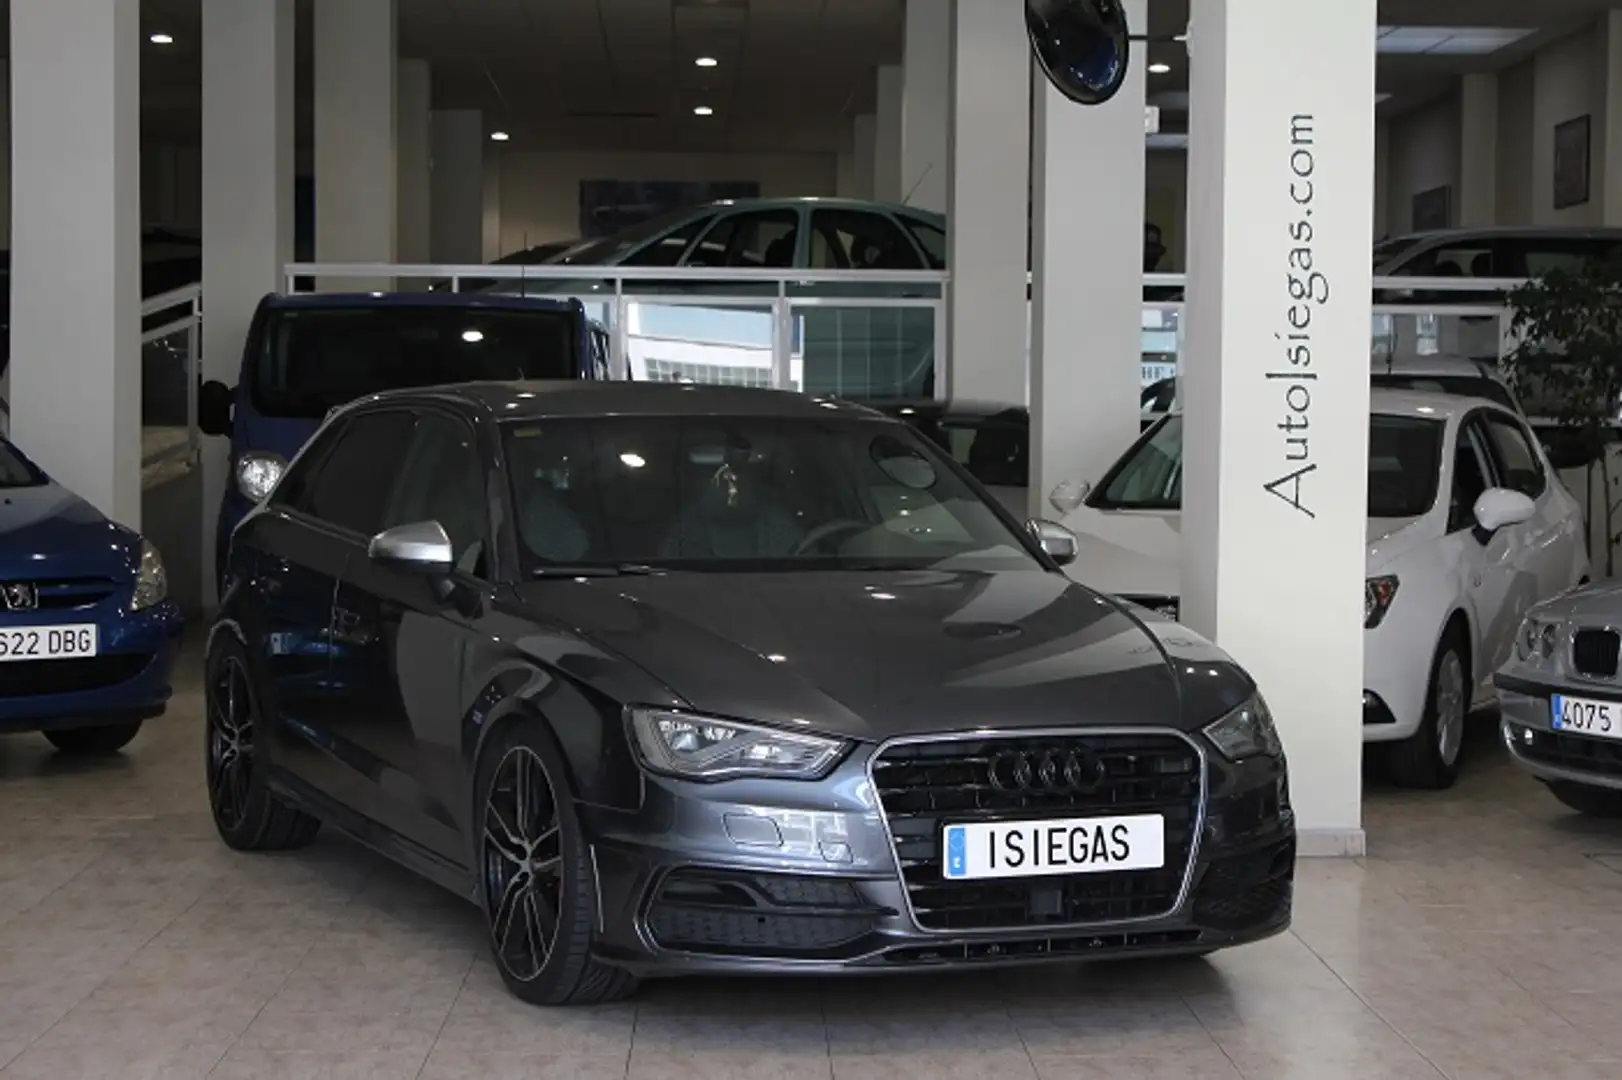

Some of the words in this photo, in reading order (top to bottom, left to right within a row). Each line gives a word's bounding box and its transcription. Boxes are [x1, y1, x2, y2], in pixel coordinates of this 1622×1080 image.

[48, 630, 91, 654] DBG
[1562, 701, 1612, 732] 4075
[988, 824, 1130, 869] ISIEGAS
